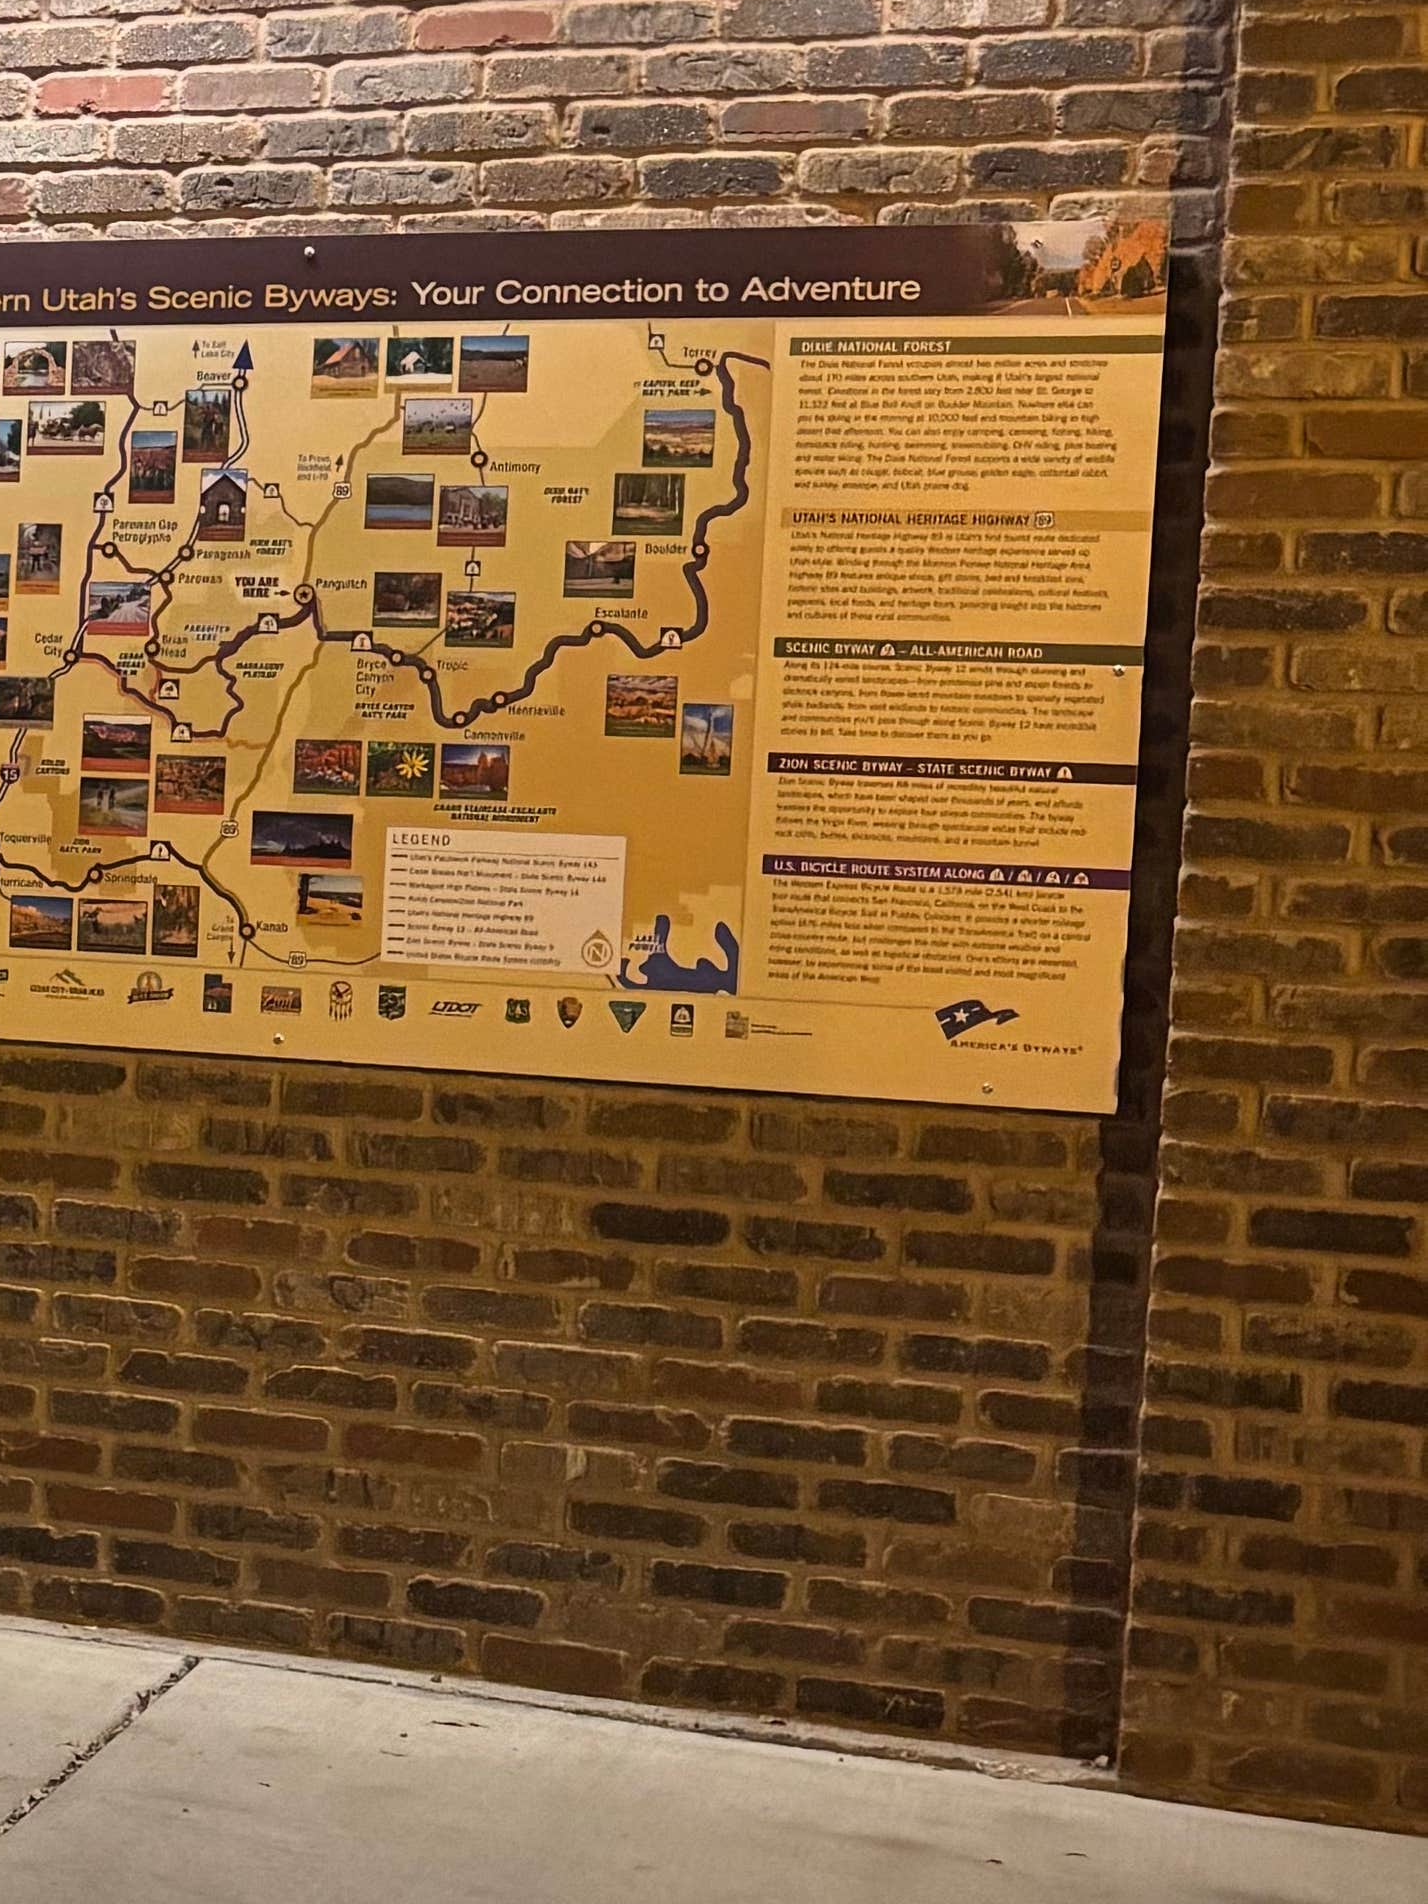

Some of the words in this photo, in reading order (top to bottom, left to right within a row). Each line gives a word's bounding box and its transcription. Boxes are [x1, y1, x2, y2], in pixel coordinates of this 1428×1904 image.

[42, 286, 137, 312] Utah's
[148, 284, 252, 310] Scenic
[265, 283, 397, 312] Byways:
[411, 280, 484, 306] Your
[495, 277, 683, 304] Connection
[695, 278, 729, 302] to
[741, 275, 921, 302] Adventure
[801, 341, 834, 352] DIXIE
[837, 341, 898, 352] NATIONAL
[904, 341, 951, 352] FOREST
[683, 347, 716, 359] Torrey
[197, 371, 231, 381] Beaver
[490, 462, 542, 474] Antimony
[336, 485, 348, 496] 89
[113, 519, 156, 530] Parowan
[159, 520, 177, 532] Gap
[793, 513, 836, 525] UTAH'S
[842, 513, 901, 525] NATIONAL
[907, 513, 967, 525] HERITAGE
[973, 514, 1029, 526] HIGHWAY
[112, 532, 171, 544] Petroglyphs
[196, 550, 250, 561] Paragonah
[645, 544, 687, 555] Boulder
[178, 573, 222, 584] Parowan
[235, 577, 255, 587] YOU
[258, 577, 278, 587] ARE
[316, 578, 367, 590] Panguitch
[243, 588, 270, 598] HERE
[595, 607, 648, 619] Escalante
[35, 634, 62, 644] Cedar
[163, 635, 188, 644] Brian
[44, 646, 62, 657] City
[162, 648, 186, 658] Head
[786, 643, 830, 654] SCENIC
[834, 643, 875, 656] BYWAY
[910, 645, 1003, 658] ALL-AMERICAN
[1008, 647, 1042, 658] ROAD
[357, 658, 386, 672] Bryce
[437, 660, 468, 671] Tropic
[356, 672, 394, 684] Canyon
[356, 685, 375, 696] City
[508, 706, 565, 717] Henrieville
[464, 729, 525, 741] Cannonville
[779, 758, 808, 770] ZION
[814, 759, 857, 771] SCENIC
[862, 760, 902, 773] BYWAY
[917, 762, 954, 775] STATE
[959, 764, 1003, 776] SCENIC
[1010, 765, 1050, 778] BYWAY
[4, 769, 17, 780] 15
[0, 832, 51, 845] Toquerville
[393, 834, 451, 846] LEGEND
[774, 860, 795, 872] U.S.
[801, 861, 846, 874] BICYCLE
[851, 863, 889, 876] ROUTE
[894, 865, 940, 878] SYSTEM
[944, 868, 984, 880] ALONG
[104, 873, 158, 885] Springdale
[256, 921, 288, 932] Kanab
[950, 1039, 1018, 1052] AMERICA'S
